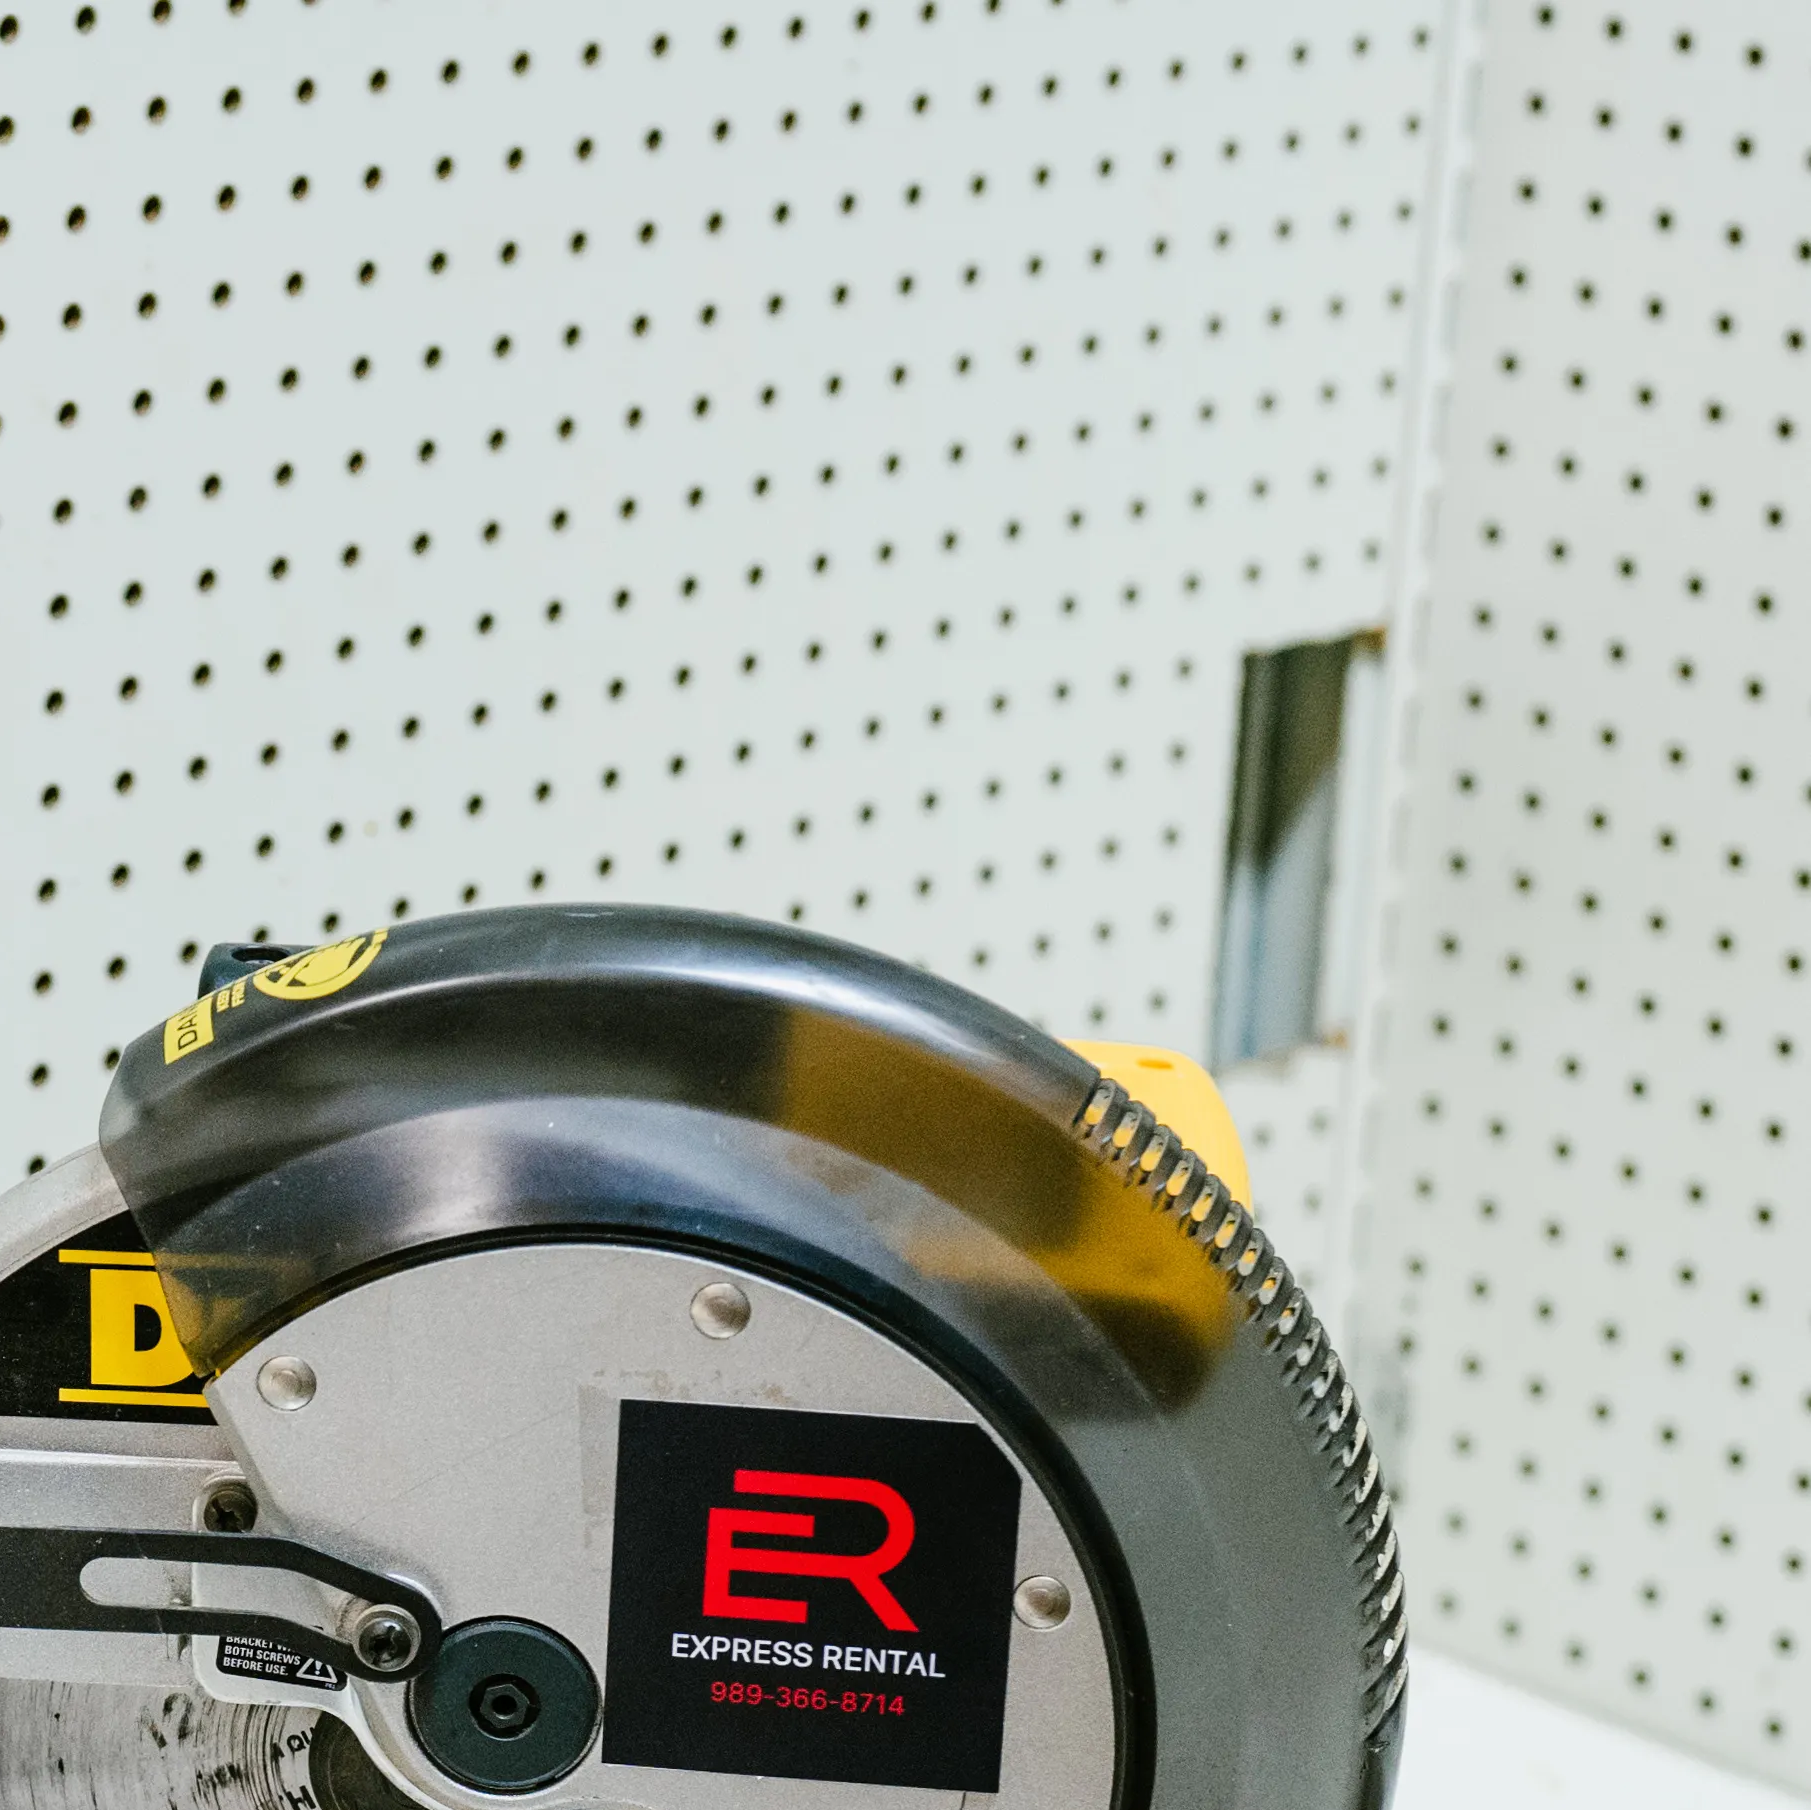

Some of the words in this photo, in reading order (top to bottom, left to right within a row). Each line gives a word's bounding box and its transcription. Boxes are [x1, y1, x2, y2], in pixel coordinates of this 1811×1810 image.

[702, 1468, 920, 1633] ER
[223, 1656, 263, 1672] BEFORE
[265, 1663, 289, 1676] USE.
[224, 1645, 254, 1658] BOTH
[256, 1649, 301, 1665] SCREWS
[671, 1632, 813, 1668] EXPRESS
[822, 1644, 946, 1678] RENTAL
[710, 1681, 906, 1716] 989-366-8714
